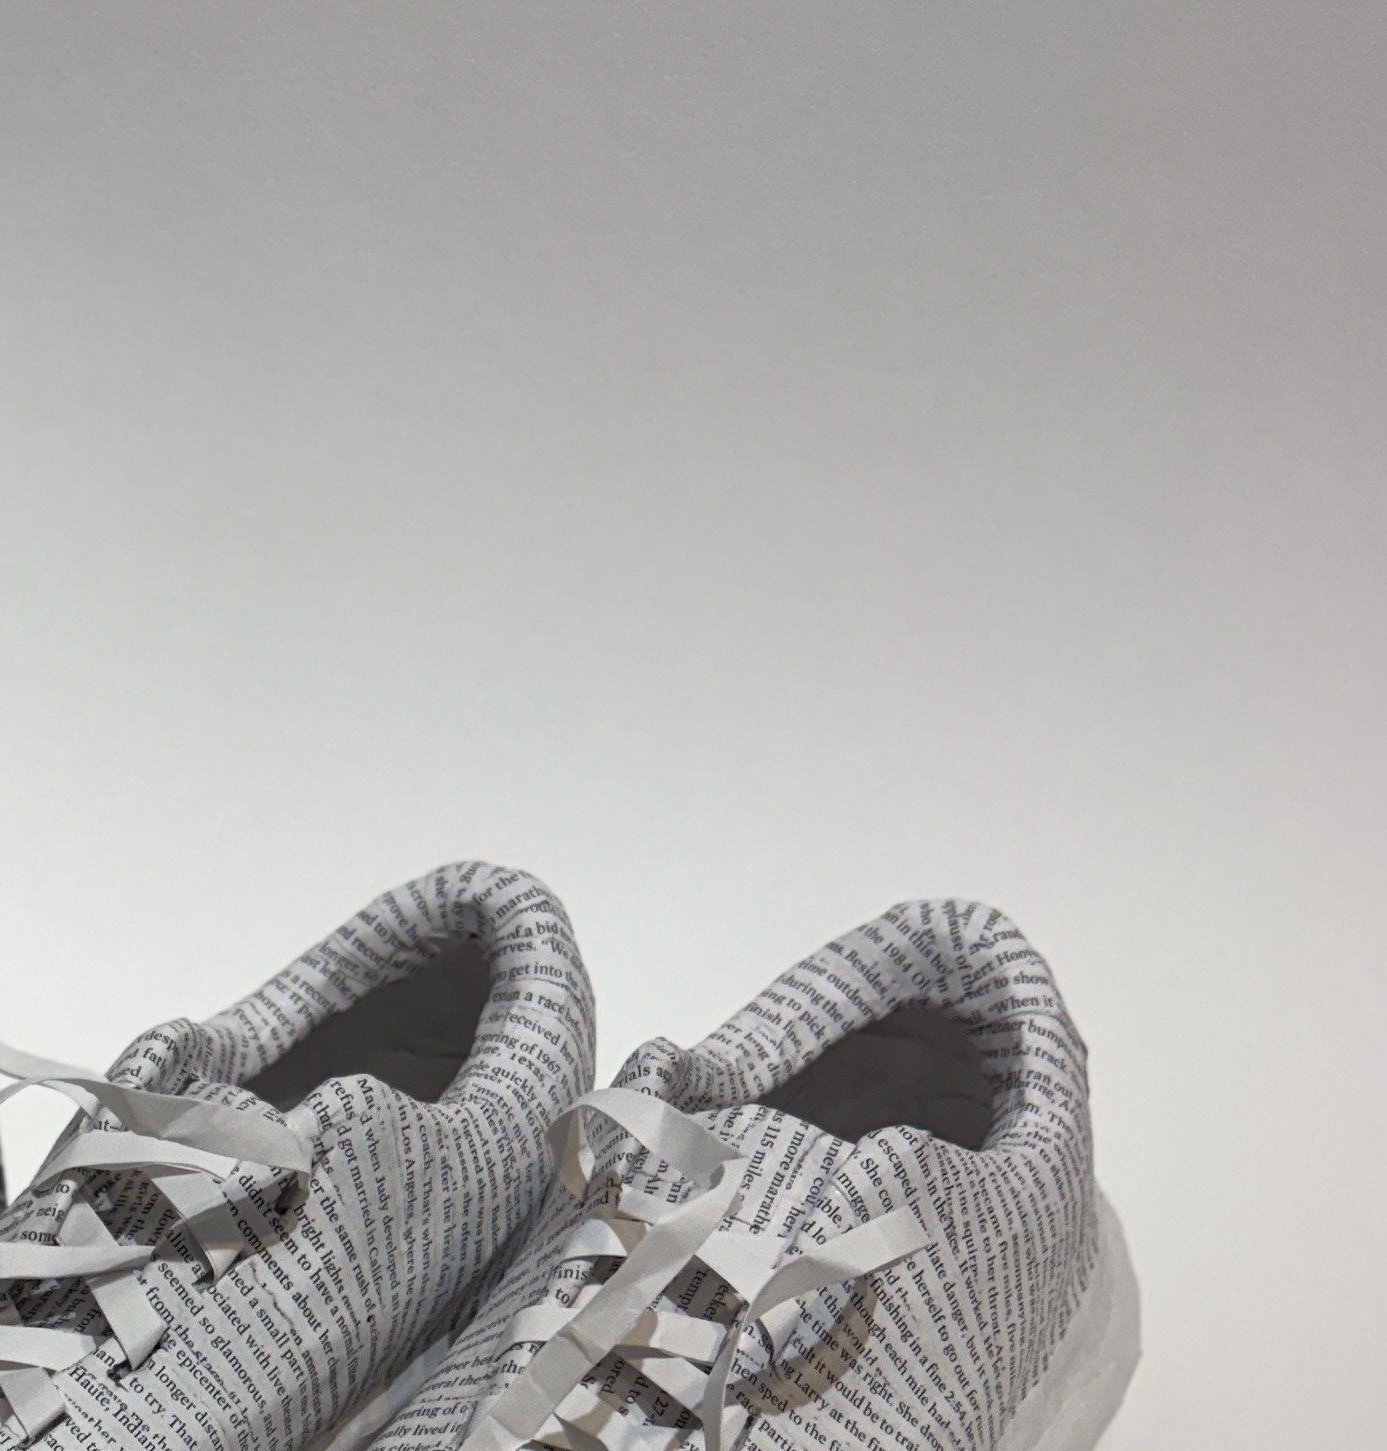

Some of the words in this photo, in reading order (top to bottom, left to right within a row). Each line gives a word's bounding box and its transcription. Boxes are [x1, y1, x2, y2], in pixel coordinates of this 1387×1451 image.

[535, 965, 562, 978] into
[780, 973, 824, 1005] during
[844, 950, 888, 995] Besides,
[799, 1011, 825, 1039] pick
[492, 1067, 537, 1103] quickly
[338, 1139, 357, 1164] got
[350, 1166, 375, 1228] married
[376, 1176, 390, 1210] Judy
[860, 1159, 882, 1187] She
[878, 1139, 917, 1198] escaped
[239, 1176, 272, 1217] didn't
[269, 1218, 298, 1255] seem
[310, 1268, 333, 1305] have
[290, 1203, 325, 1252] bright
[320, 1251, 344, 1293] lights
[335, 1225, 356, 1262] same
[353, 1264, 368, 1297] rush
[382, 1215, 400, 1290] developed
[238, 1219, 293, 1290] comments
[292, 1292, 321, 1332] about
[319, 1329, 333, 1355] her
[161, 1263, 203, 1316] seemed
[199, 1318, 214, 1334] so
[211, 1336, 266, 1409] glamorous,
[257, 1309, 289, 1348] small
[281, 1349, 304, 1380] part
[850, 1290, 886, 1343] though
[885, 1343, 907, 1376] each
[906, 1375, 928, 1406] mile
[868, 1278, 916, 1343] finishing
[944, 1391, 966, 1427] 2:54,
[912, 1271, 945, 1323] herself
[955, 1365, 969, 1389] out
[69, 1363, 109, 1411] Haute,
[155, 1366, 196, 1410] longer
[177, 1343, 231, 1411] epicenter
[246, 1335, 270, 1370] with
[267, 1366, 285, 1396] live
[794, 1372, 828, 1410] Larry
[827, 1371, 865, 1409] would
[145, 1393, 166, 1414] try.
[169, 1415, 197, 1450] That
[758, 1383, 788, 1412] sped
[863, 1372, 893, 1406] right.
[896, 1402, 918, 1427] She
